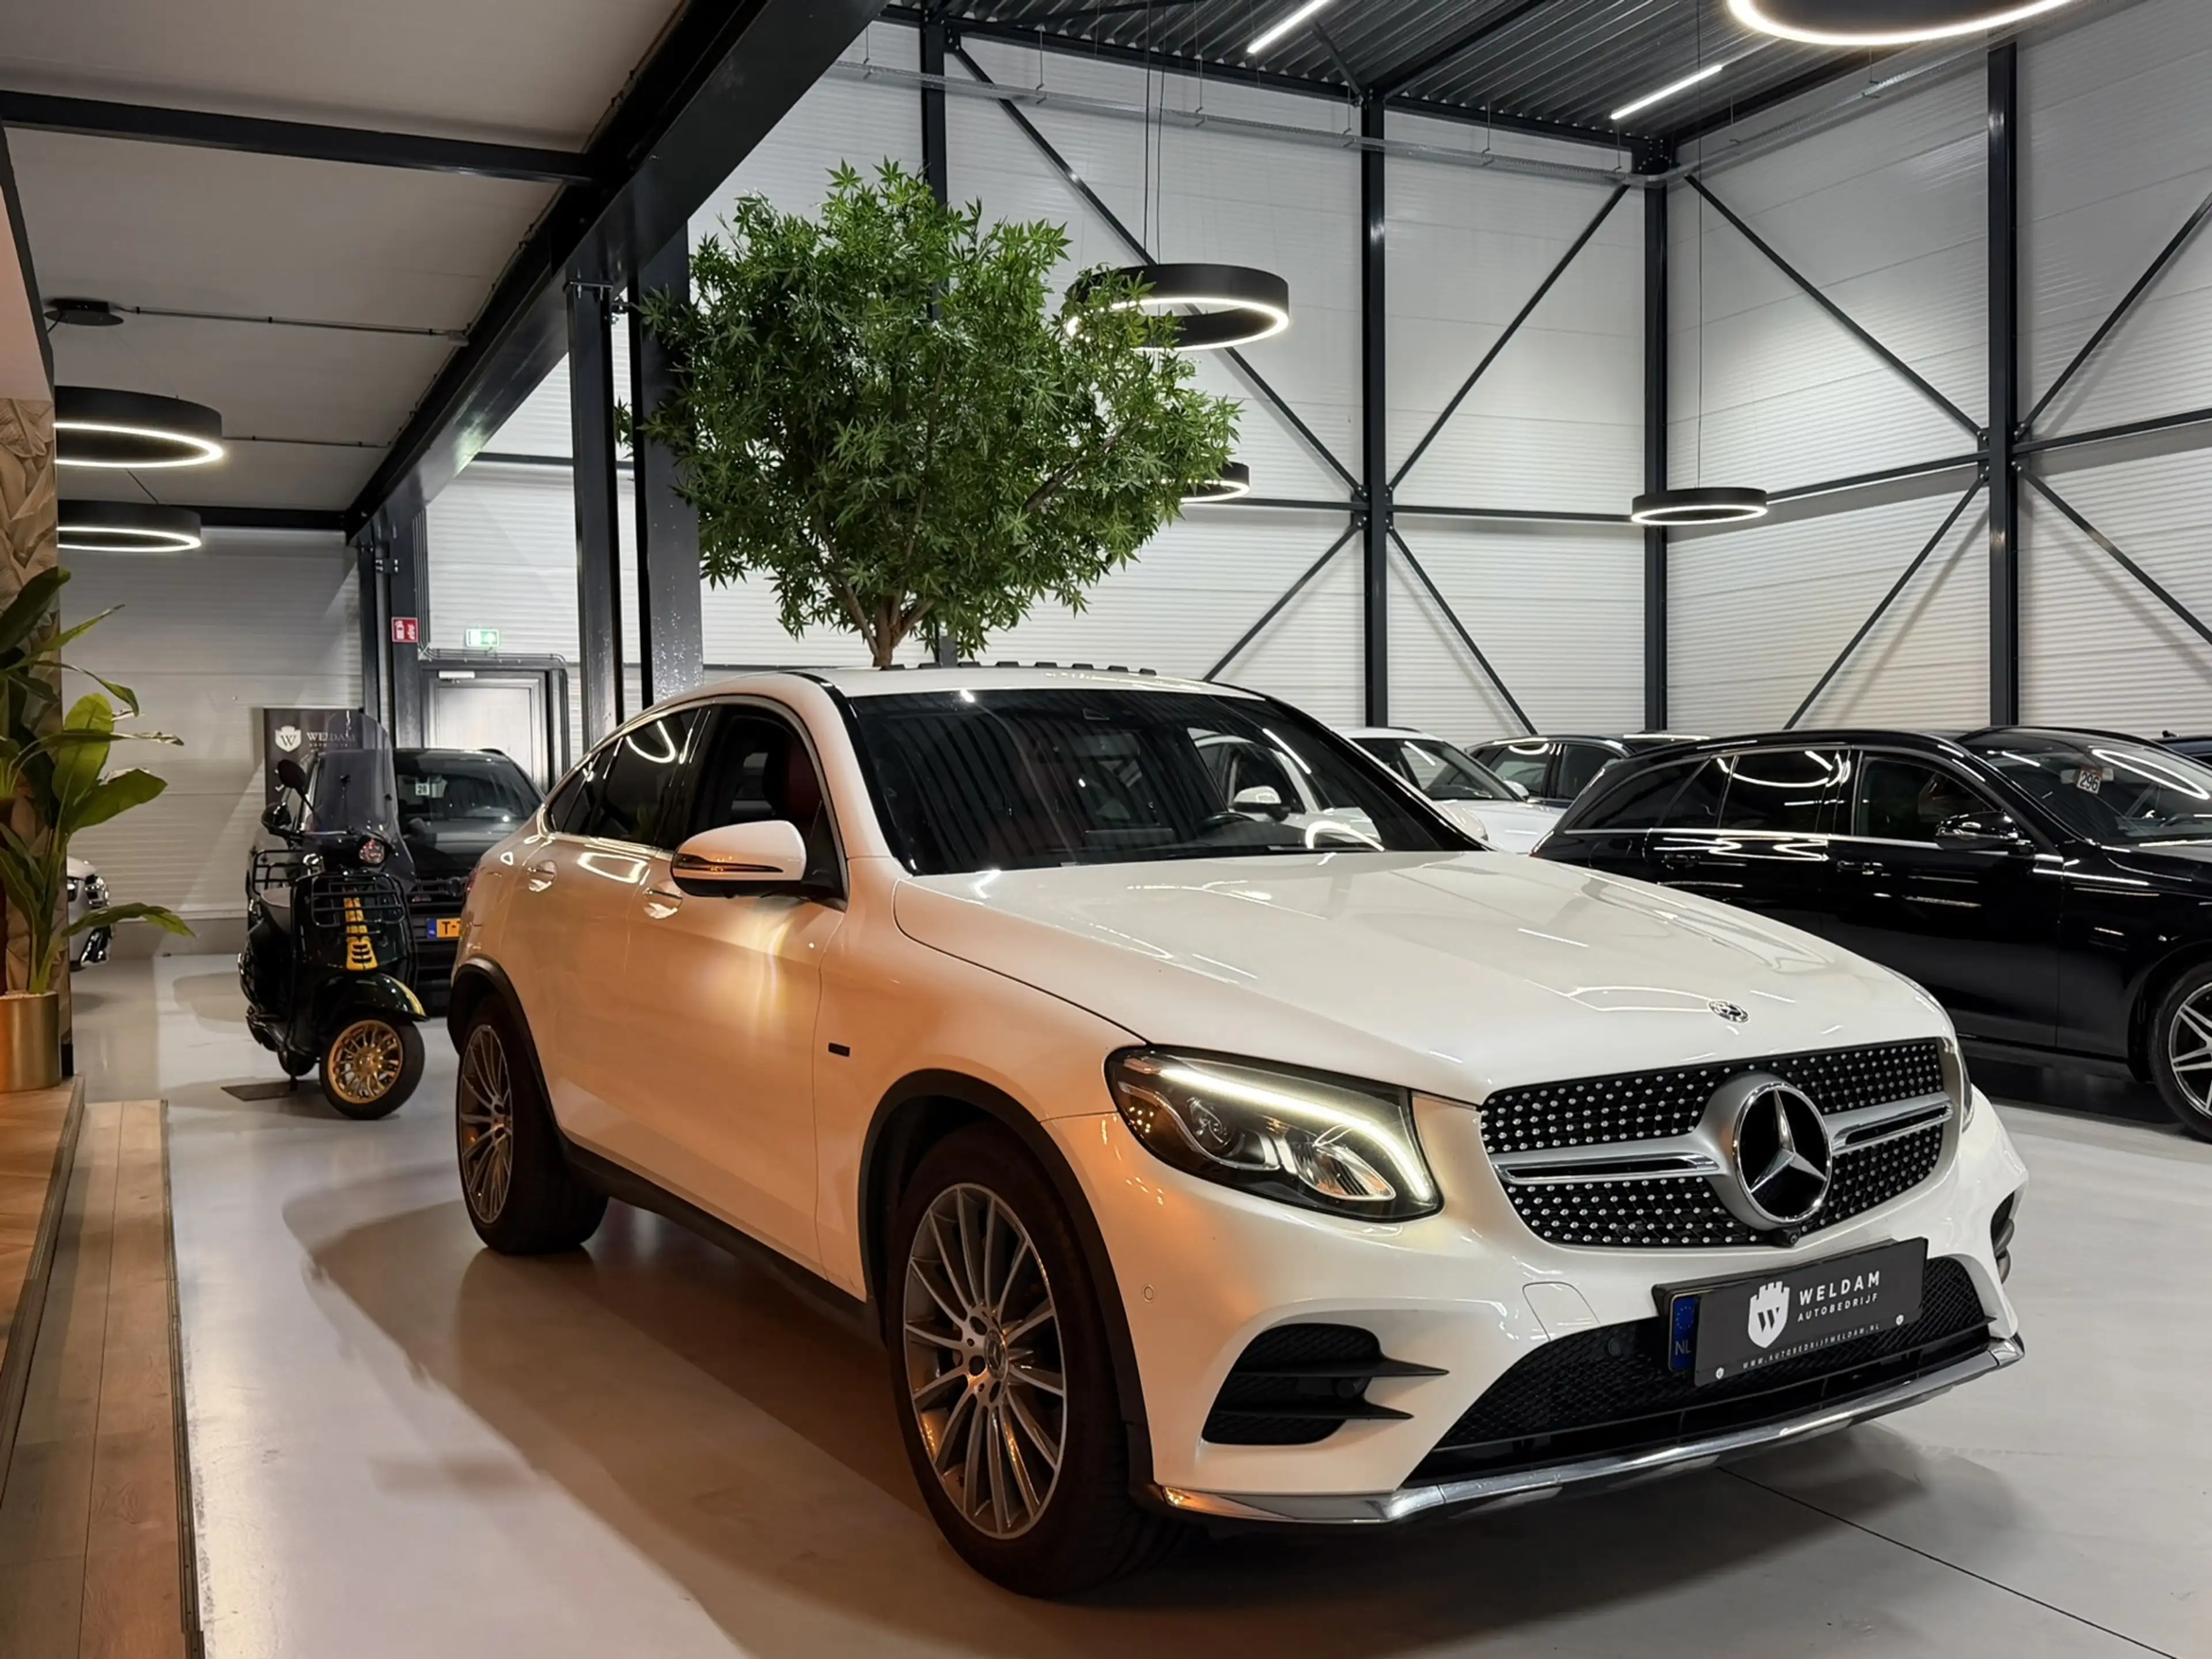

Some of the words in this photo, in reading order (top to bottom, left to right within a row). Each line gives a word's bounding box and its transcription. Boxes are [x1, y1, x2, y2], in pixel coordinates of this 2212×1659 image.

[2080, 771, 2100, 791] 296
[1799, 1270, 1880, 1306] WELDAM
[1757, 1306, 1781, 1333] W
[1797, 1293, 1878, 1323] AUTOBEDRIJF
[1675, 1338, 1692, 1356] NL
[1743, 1323, 1880, 1369] WWW.AUTOBEDRIJFWELDAM.NL
